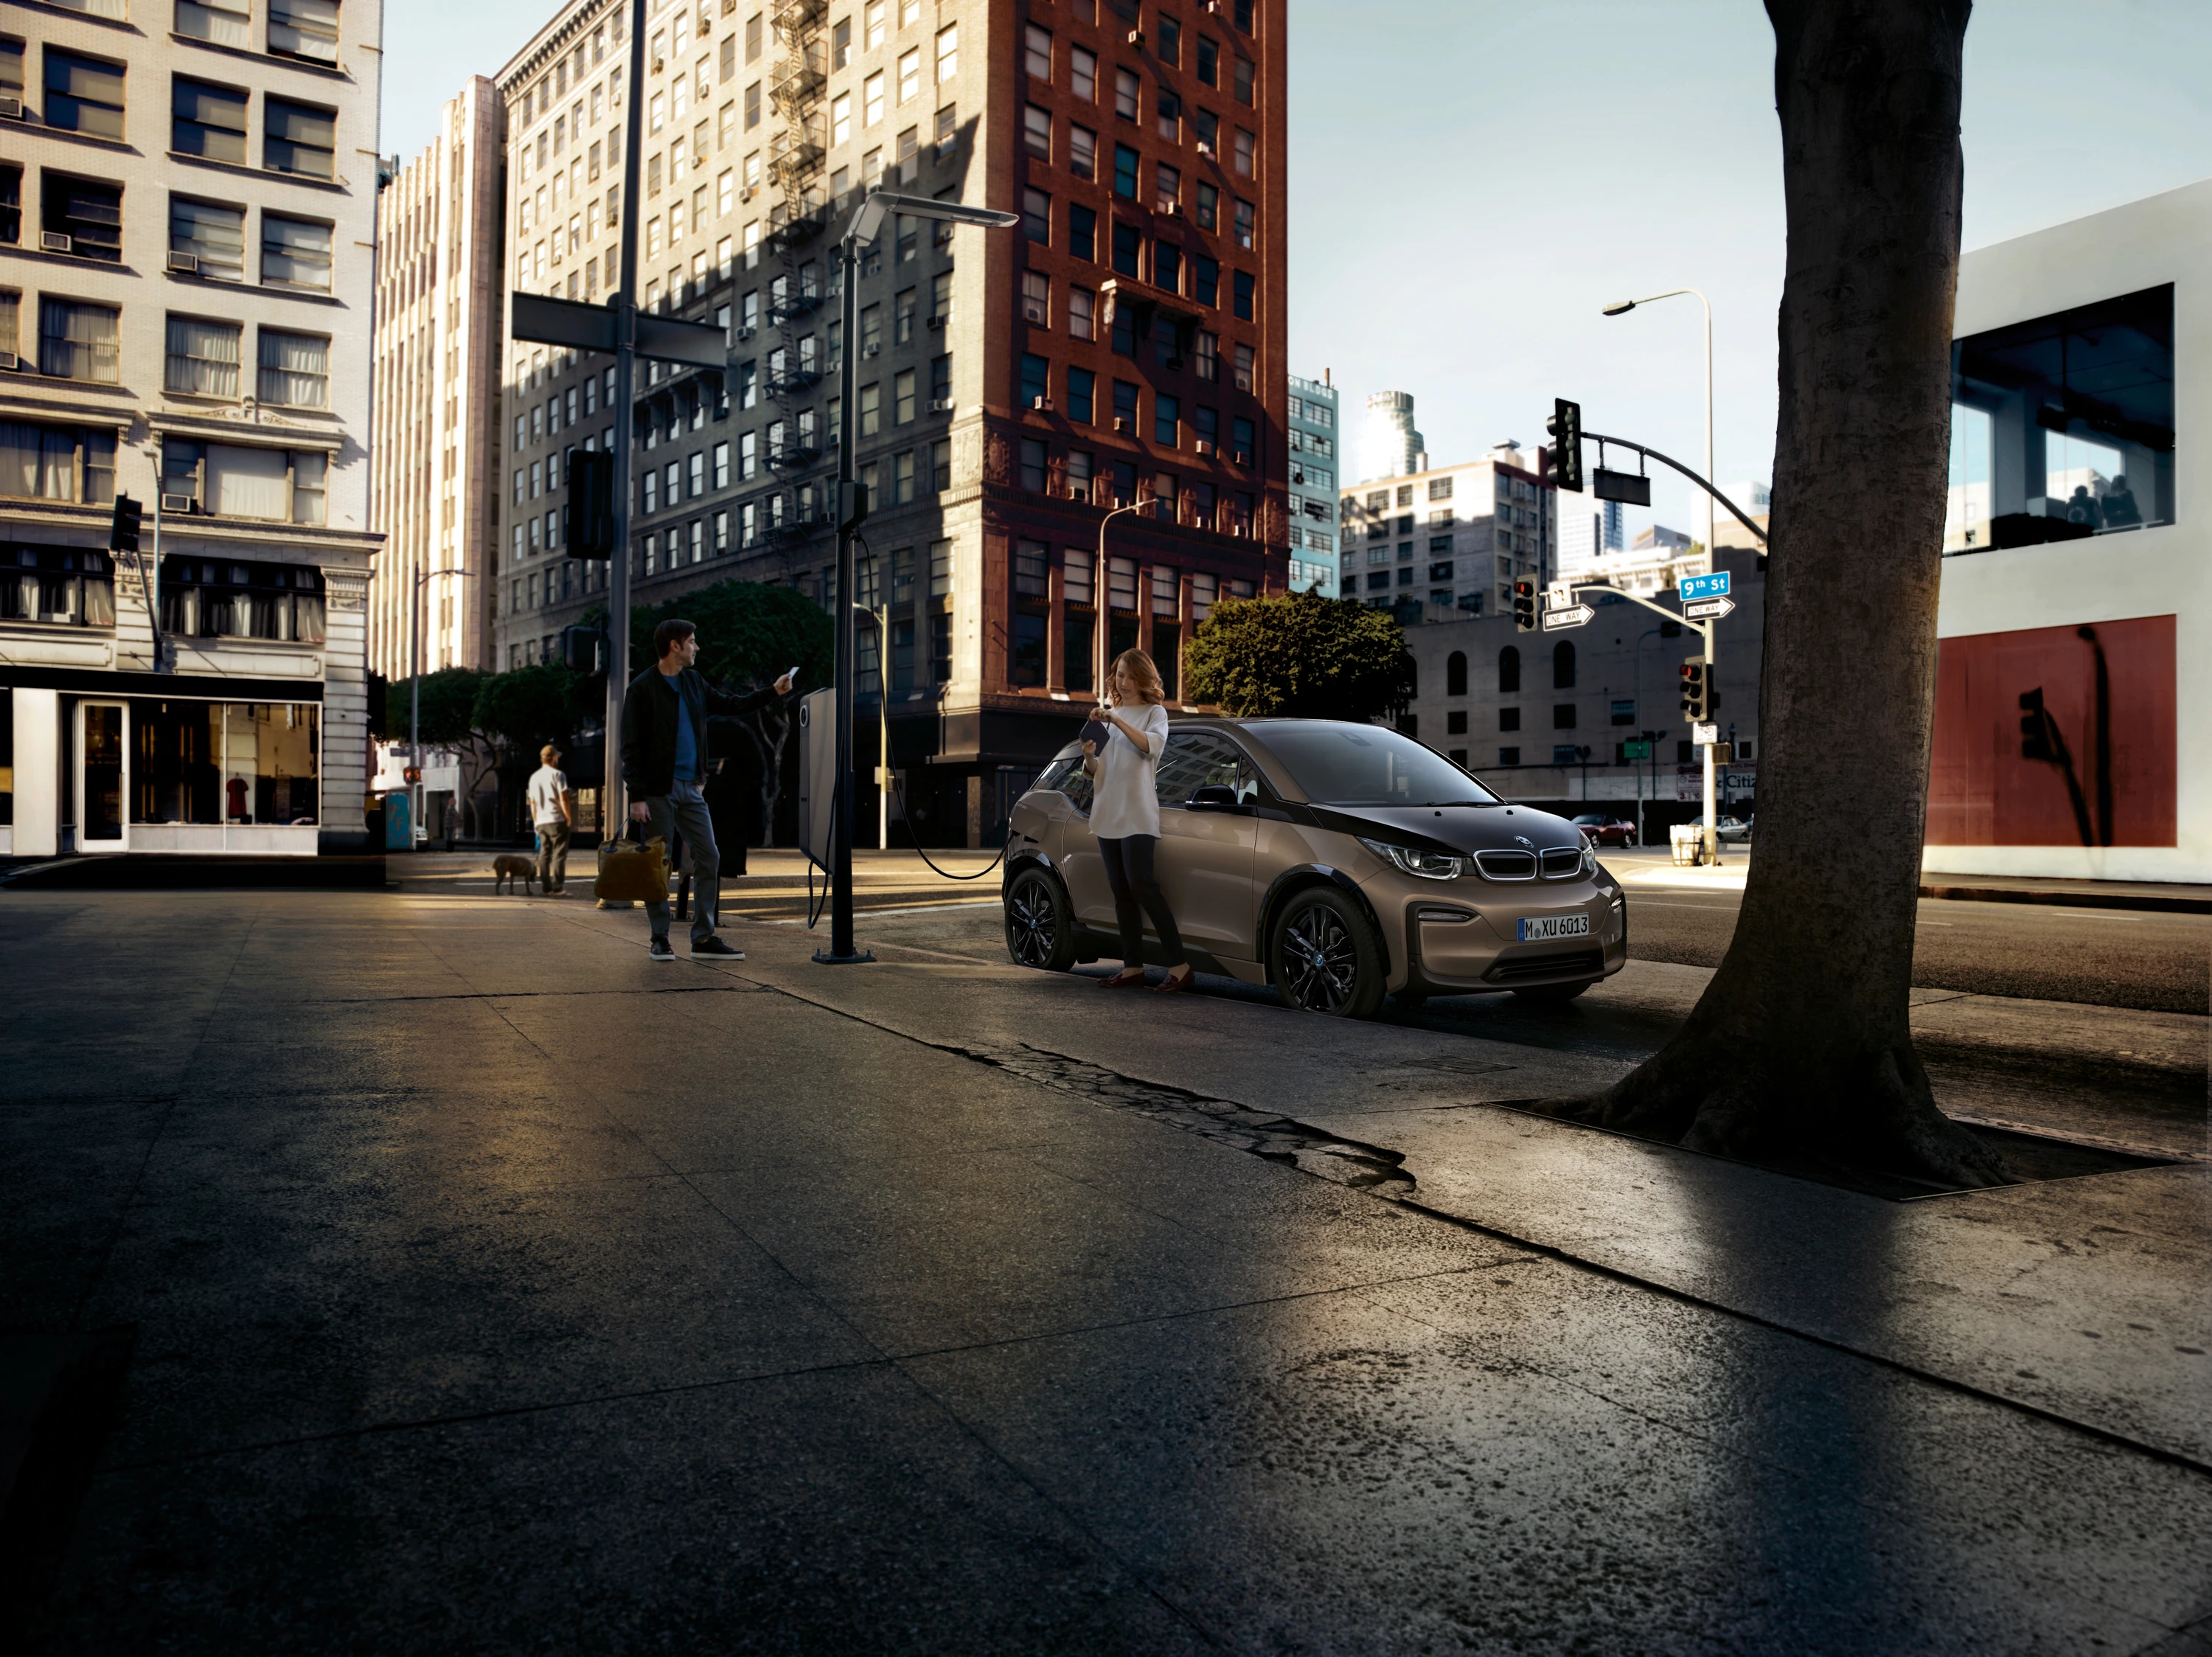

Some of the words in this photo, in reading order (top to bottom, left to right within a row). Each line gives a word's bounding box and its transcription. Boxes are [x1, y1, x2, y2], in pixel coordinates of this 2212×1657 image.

[1304, 381, 1333, 400] BLDGS
[1684, 580, 1705, 596] 9th
[1711, 578, 1725, 591] St
[1547, 614, 1561, 625] ONE
[1565, 611, 1580, 621] WAY
[1689, 606, 1703, 615] ONE
[1705, 604, 1719, 612] WAY
[1526, 921, 1533, 938] M
[1542, 919, 1557, 937] XU
[1559, 917, 1587, 934] 6013
